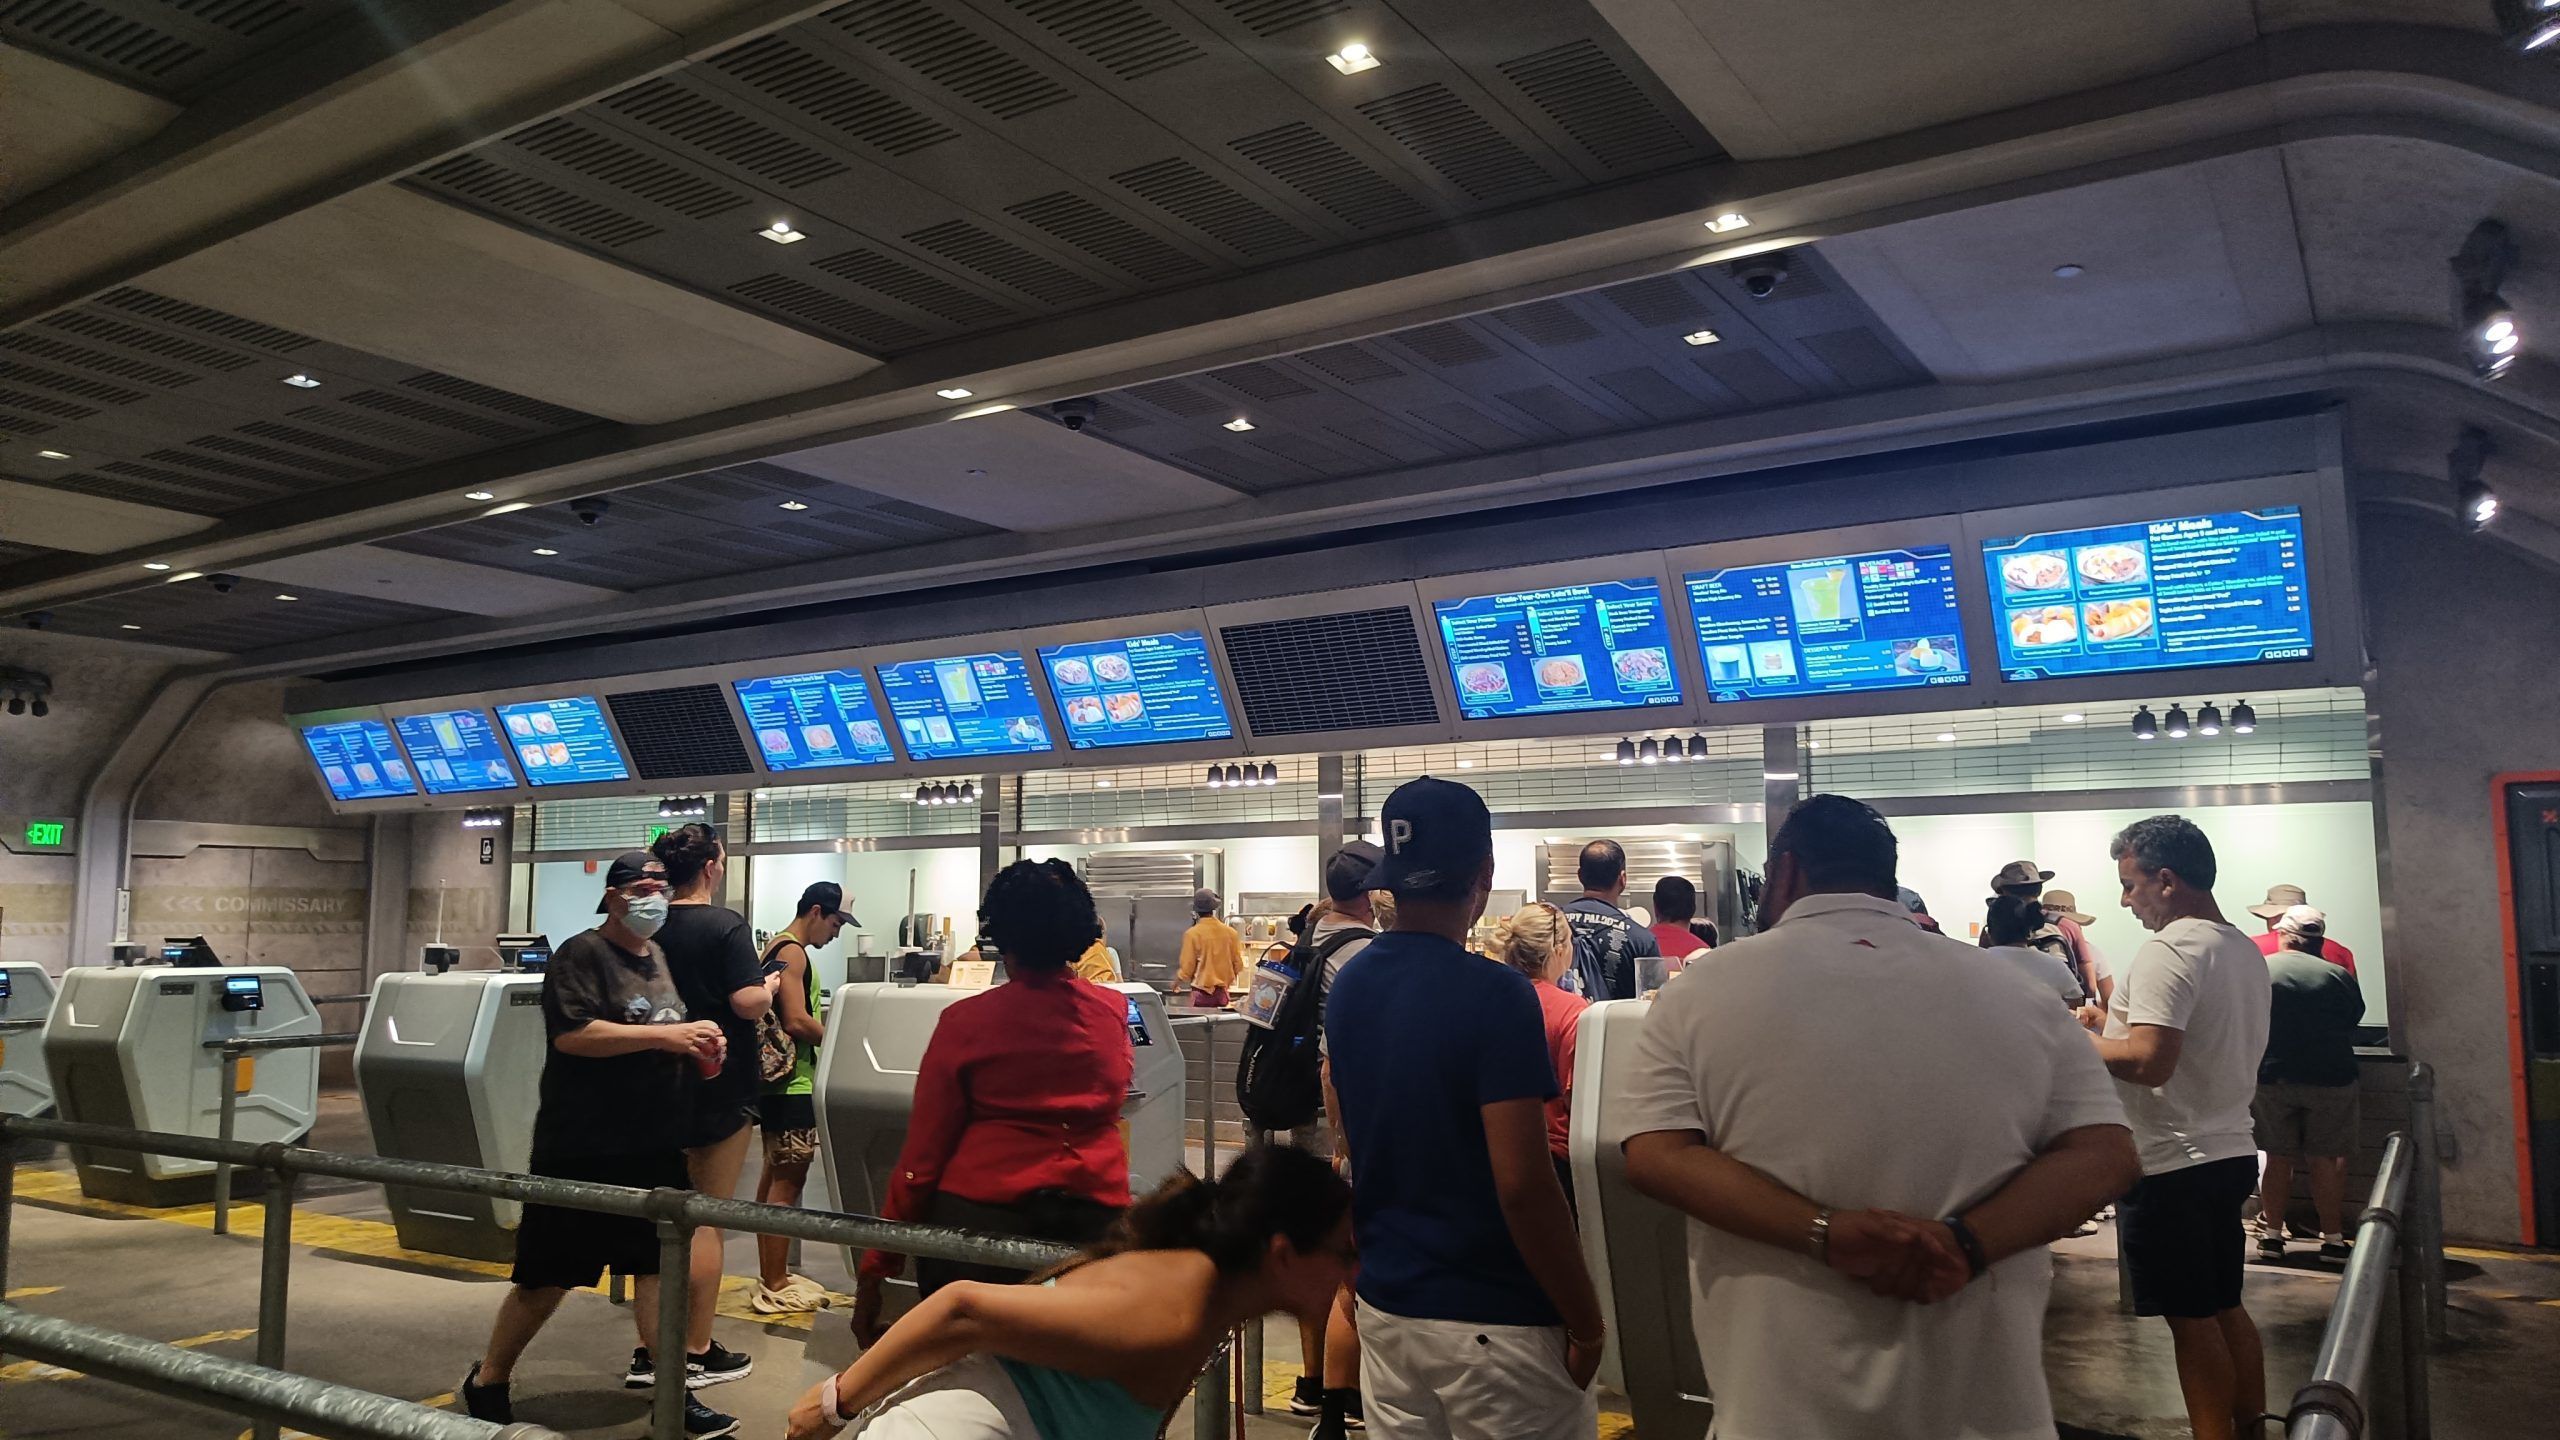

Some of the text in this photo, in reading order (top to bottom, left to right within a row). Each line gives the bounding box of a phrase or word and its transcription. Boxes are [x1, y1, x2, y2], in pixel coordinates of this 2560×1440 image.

[2149, 518, 2213, 534] Kids' Meals
[1495, 591, 1550, 604] Create-Your-Own
[1572, 587, 1590, 595] Bowl
[32, 823, 64, 845] EXIT
[1391, 819, 1412, 855] P
[214, 896, 345, 913] COMMISSARY
